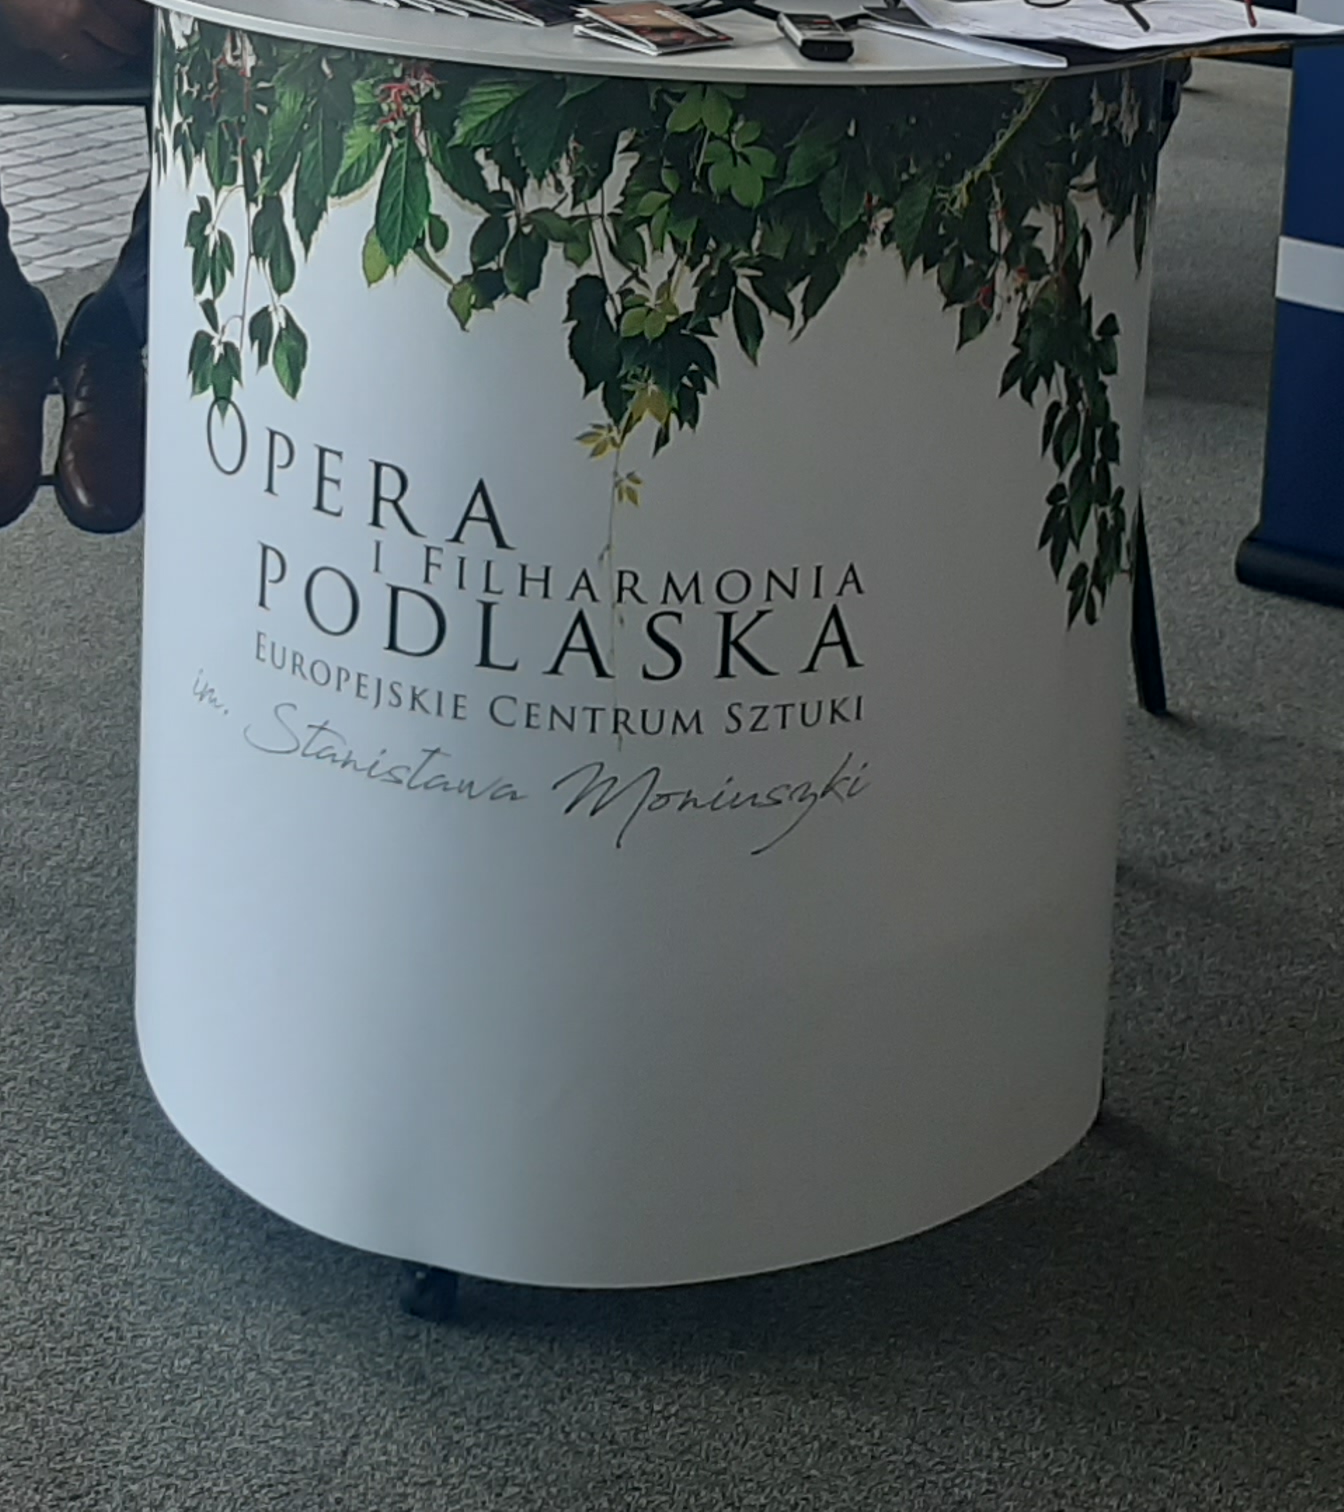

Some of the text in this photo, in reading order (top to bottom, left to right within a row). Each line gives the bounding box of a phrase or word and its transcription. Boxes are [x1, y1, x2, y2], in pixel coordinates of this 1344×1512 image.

[205, 397, 518, 552] OPERA
[257, 540, 865, 682] PODLASKA
[371, 539, 867, 606] I FILHARMONIA
[255, 630, 865, 737] EUROPEJSKIE CENTRUM SZTUKI
[550, 750, 872, 857] Moniuszki
